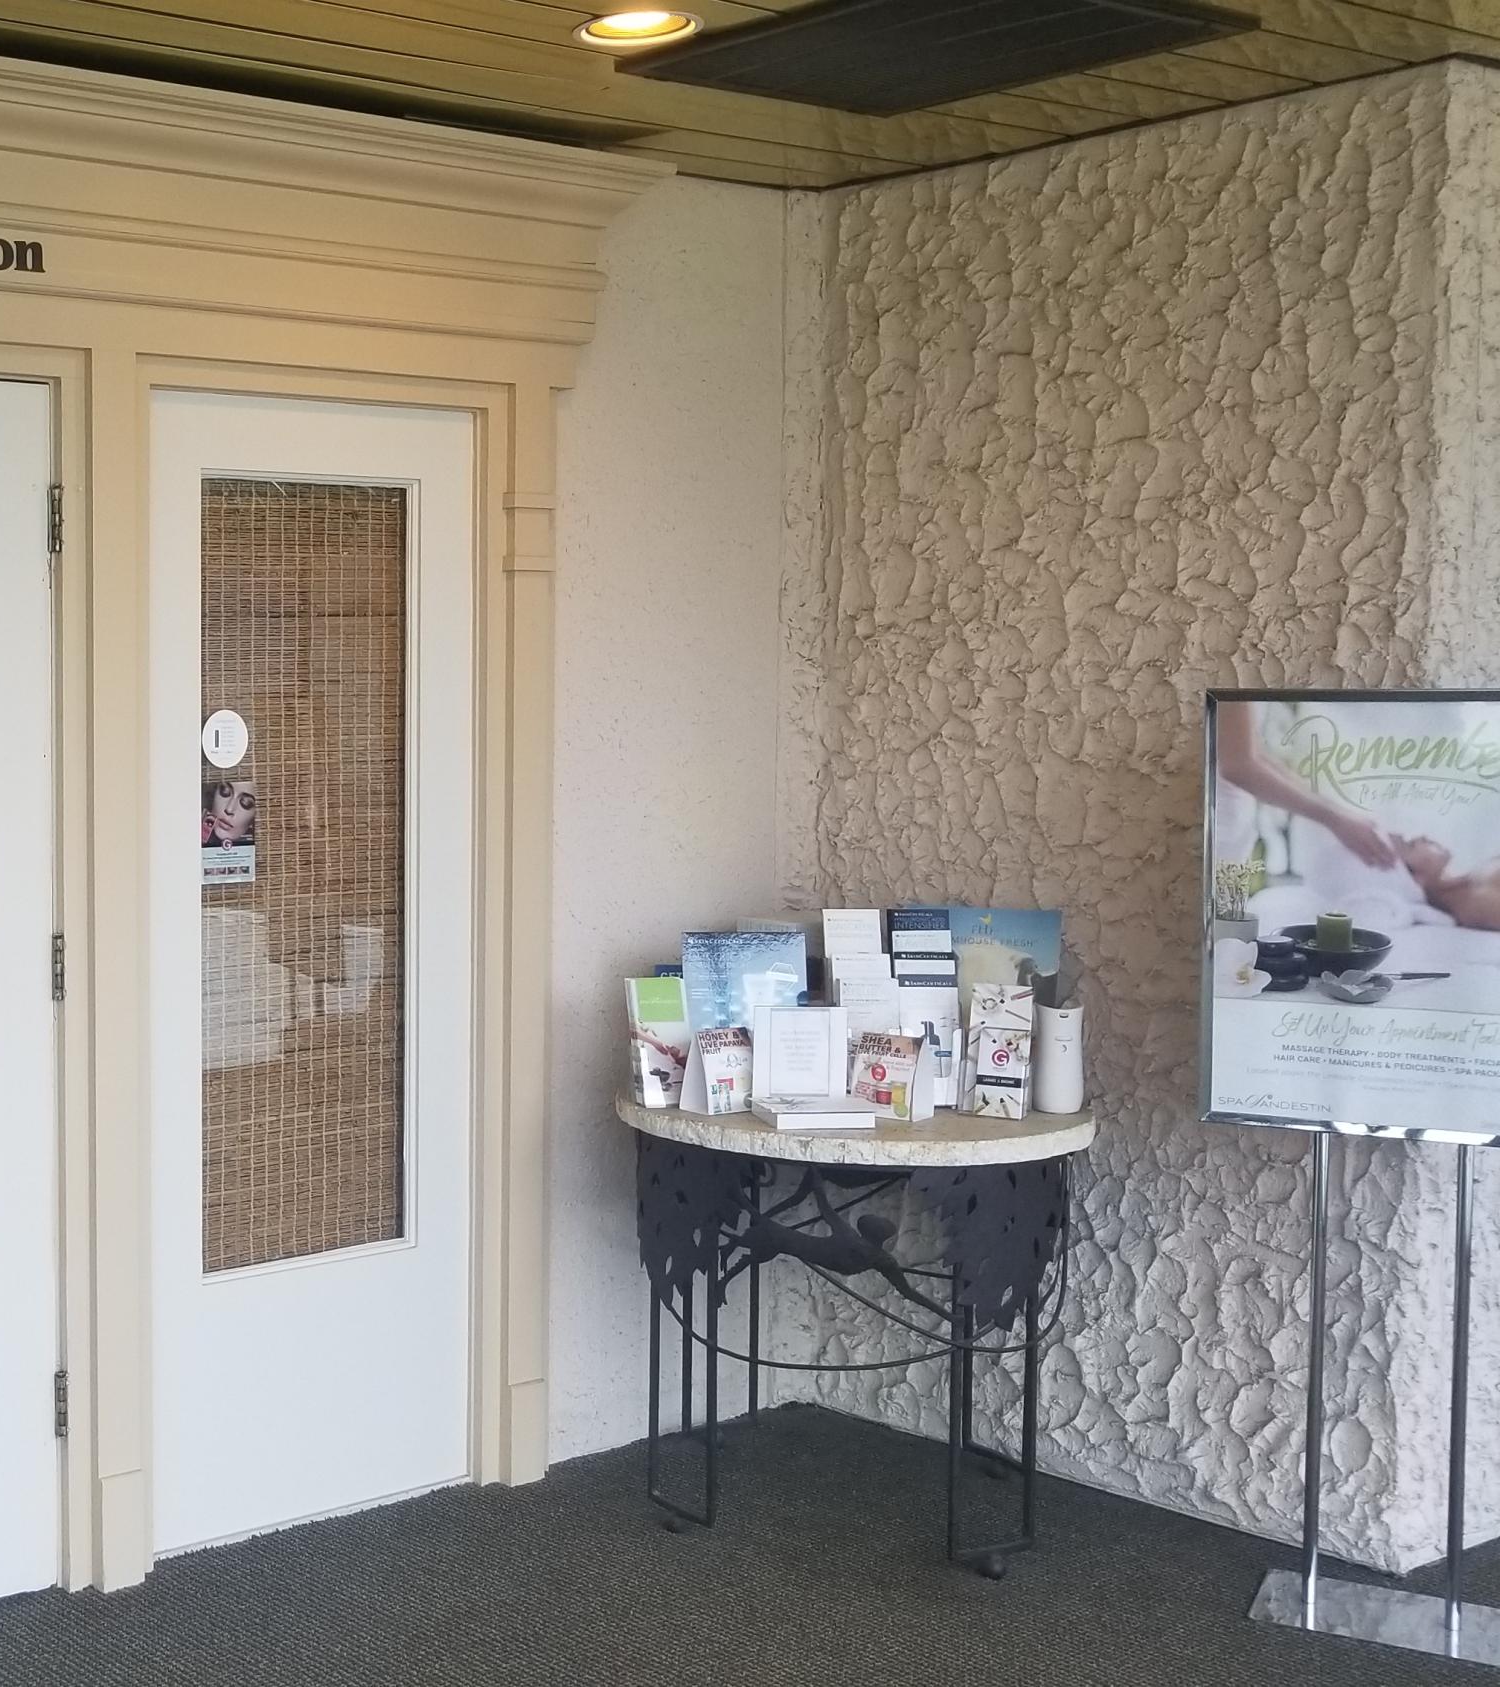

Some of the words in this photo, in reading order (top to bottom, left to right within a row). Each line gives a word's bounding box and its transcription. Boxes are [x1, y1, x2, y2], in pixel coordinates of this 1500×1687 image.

[699, 1032, 729, 1041] HONEY
[861, 1035, 892, 1046] SHEA
[701, 1040, 718, 1049] LIVE
[719, 1039, 744, 1048] PAPAYA
[859, 1043, 892, 1052] BUTTER
[1282, 1044, 1325, 1054] MASSAGE
[1328, 1047, 1369, 1057] THERAPY
[1377, 1051, 1401, 1059] BODY
[1405, 1052, 1466, 1064] TREATMENTS
[1297, 1055, 1321, 1063] CARE
[1328, 1058, 1382, 1069] MANICURES
[1394, 1062, 1446, 1073] PEDICURES
[1454, 1067, 1472, 1075] SPA
[1218, 1096, 1244, 1106] SPA
